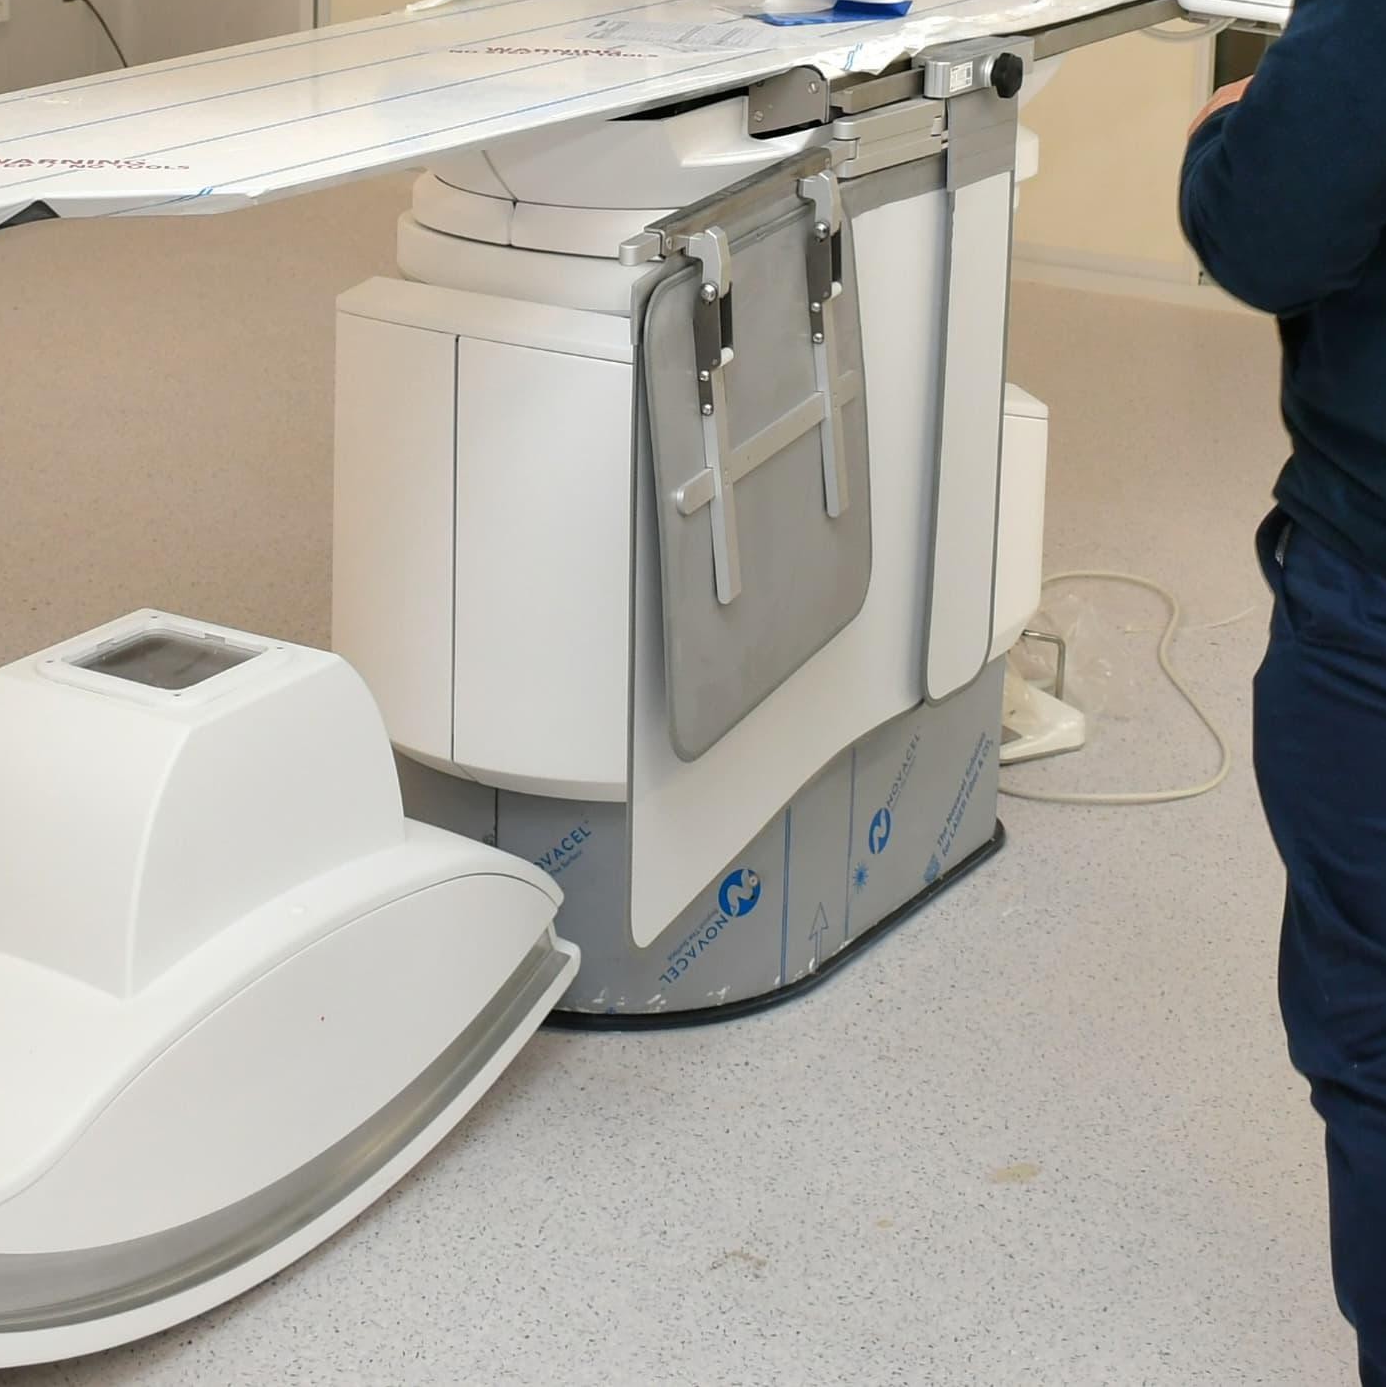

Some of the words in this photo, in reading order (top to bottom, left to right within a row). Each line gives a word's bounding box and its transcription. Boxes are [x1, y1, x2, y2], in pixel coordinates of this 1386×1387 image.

[886, 733, 919, 807] NOVACEL
[533, 826, 592, 871] VACEL
[659, 914, 728, 984] NOVACEL
